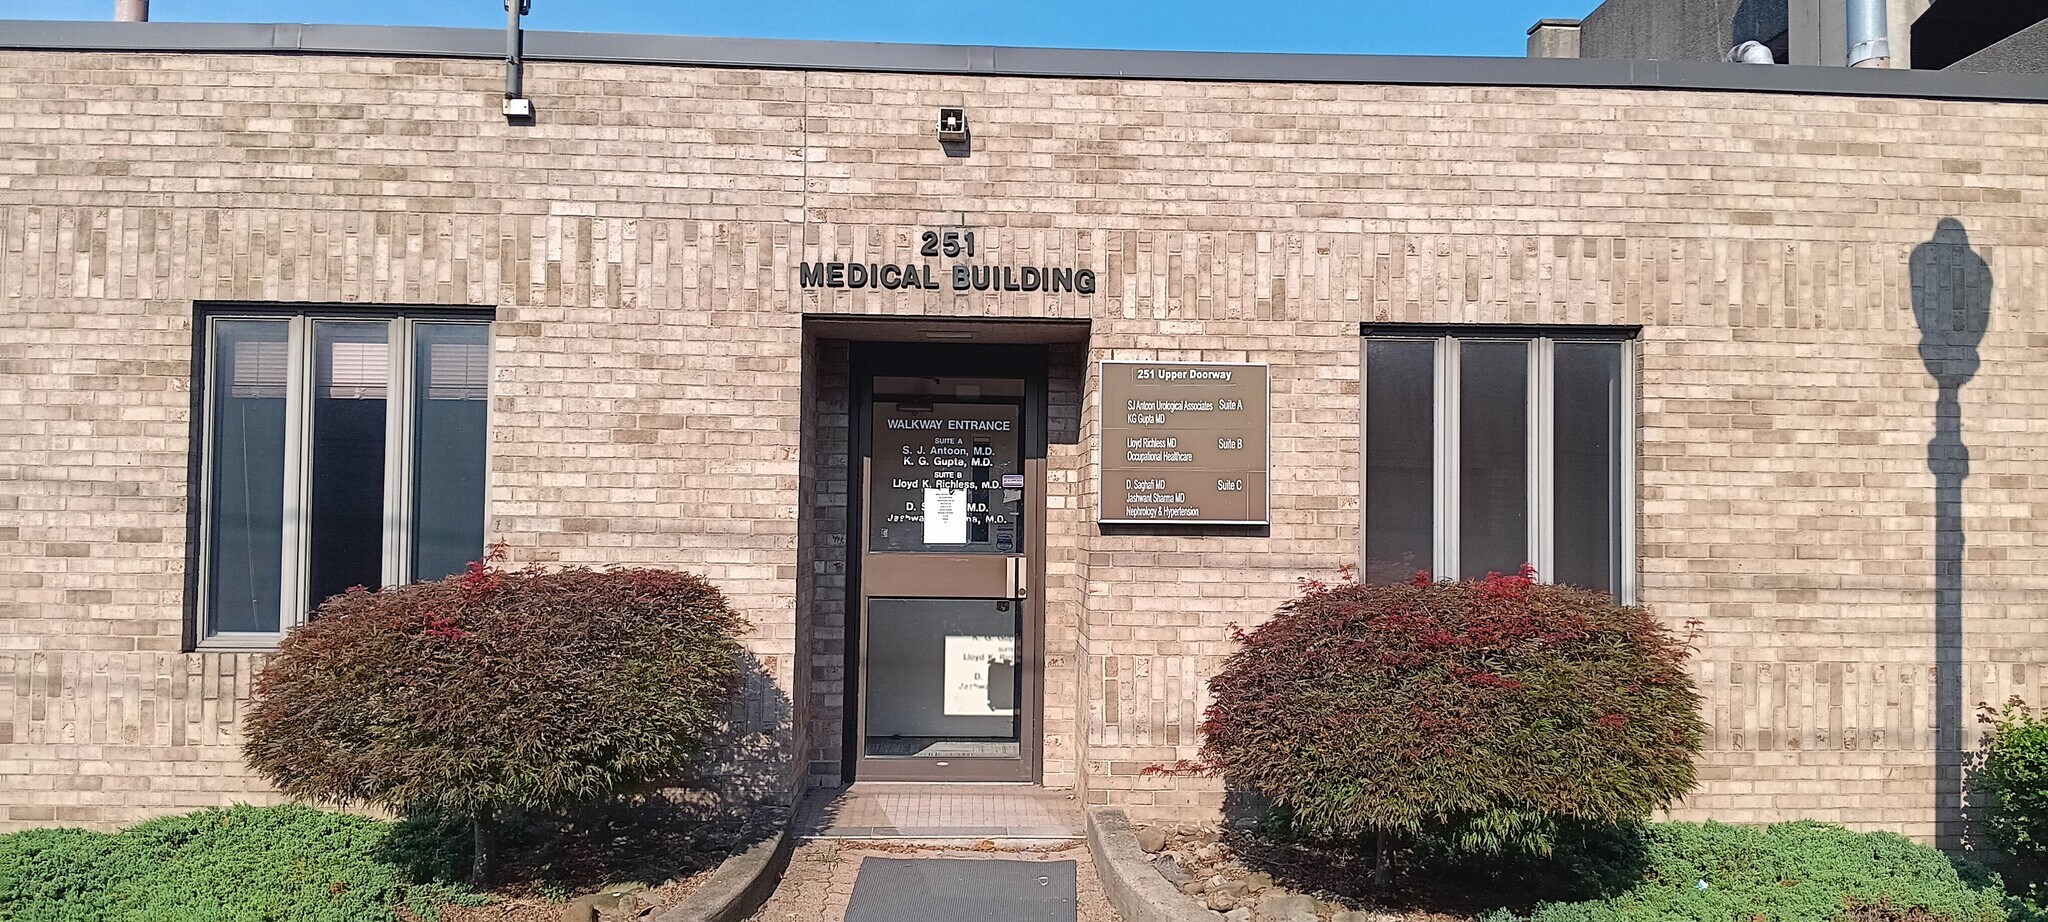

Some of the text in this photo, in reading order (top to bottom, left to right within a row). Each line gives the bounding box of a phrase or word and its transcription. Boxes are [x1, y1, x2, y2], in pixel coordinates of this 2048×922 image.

[921, 231, 974, 257] 251
[800, 262, 1095, 293] MEDICAL BUILDING
[1137, 369, 1232, 381] 251 Upper Doorway
[1127, 400, 1213, 413] SJ Antoon Urological Associates
[1219, 399, 1243, 410] Suite A
[888, 419, 1010, 431] WALKWAY ENTRANCE
[1127, 414, 1165, 426] KG Gupta MD
[1127, 438, 1177, 450] Lloyd Richless MD
[1218, 438, 1242, 449] Suite B
[902, 446, 995, 456] S. J. Antoon, M.D.
[1127, 451, 1193, 463] Occupational Healthcare
[904, 457, 994, 467] K. G. Gupta, M.D.
[893, 479, 918, 489] Lloyd
[922, 479, 931, 488] K.
[936, 480, 977, 490] Richless,
[982, 481, 1002, 489] M.D.
[1126, 479, 1165, 492] D. Saghafi MD
[1217, 480, 1242, 491] Suite C
[1126, 493, 1185, 503] Jashwant Sharma MD
[906, 502, 916, 511] D.
[967, 503, 988, 512] M.D.
[1126, 506, 1199, 518] Nephrology & Hypertension
[985, 515, 1006, 523] M.D.
